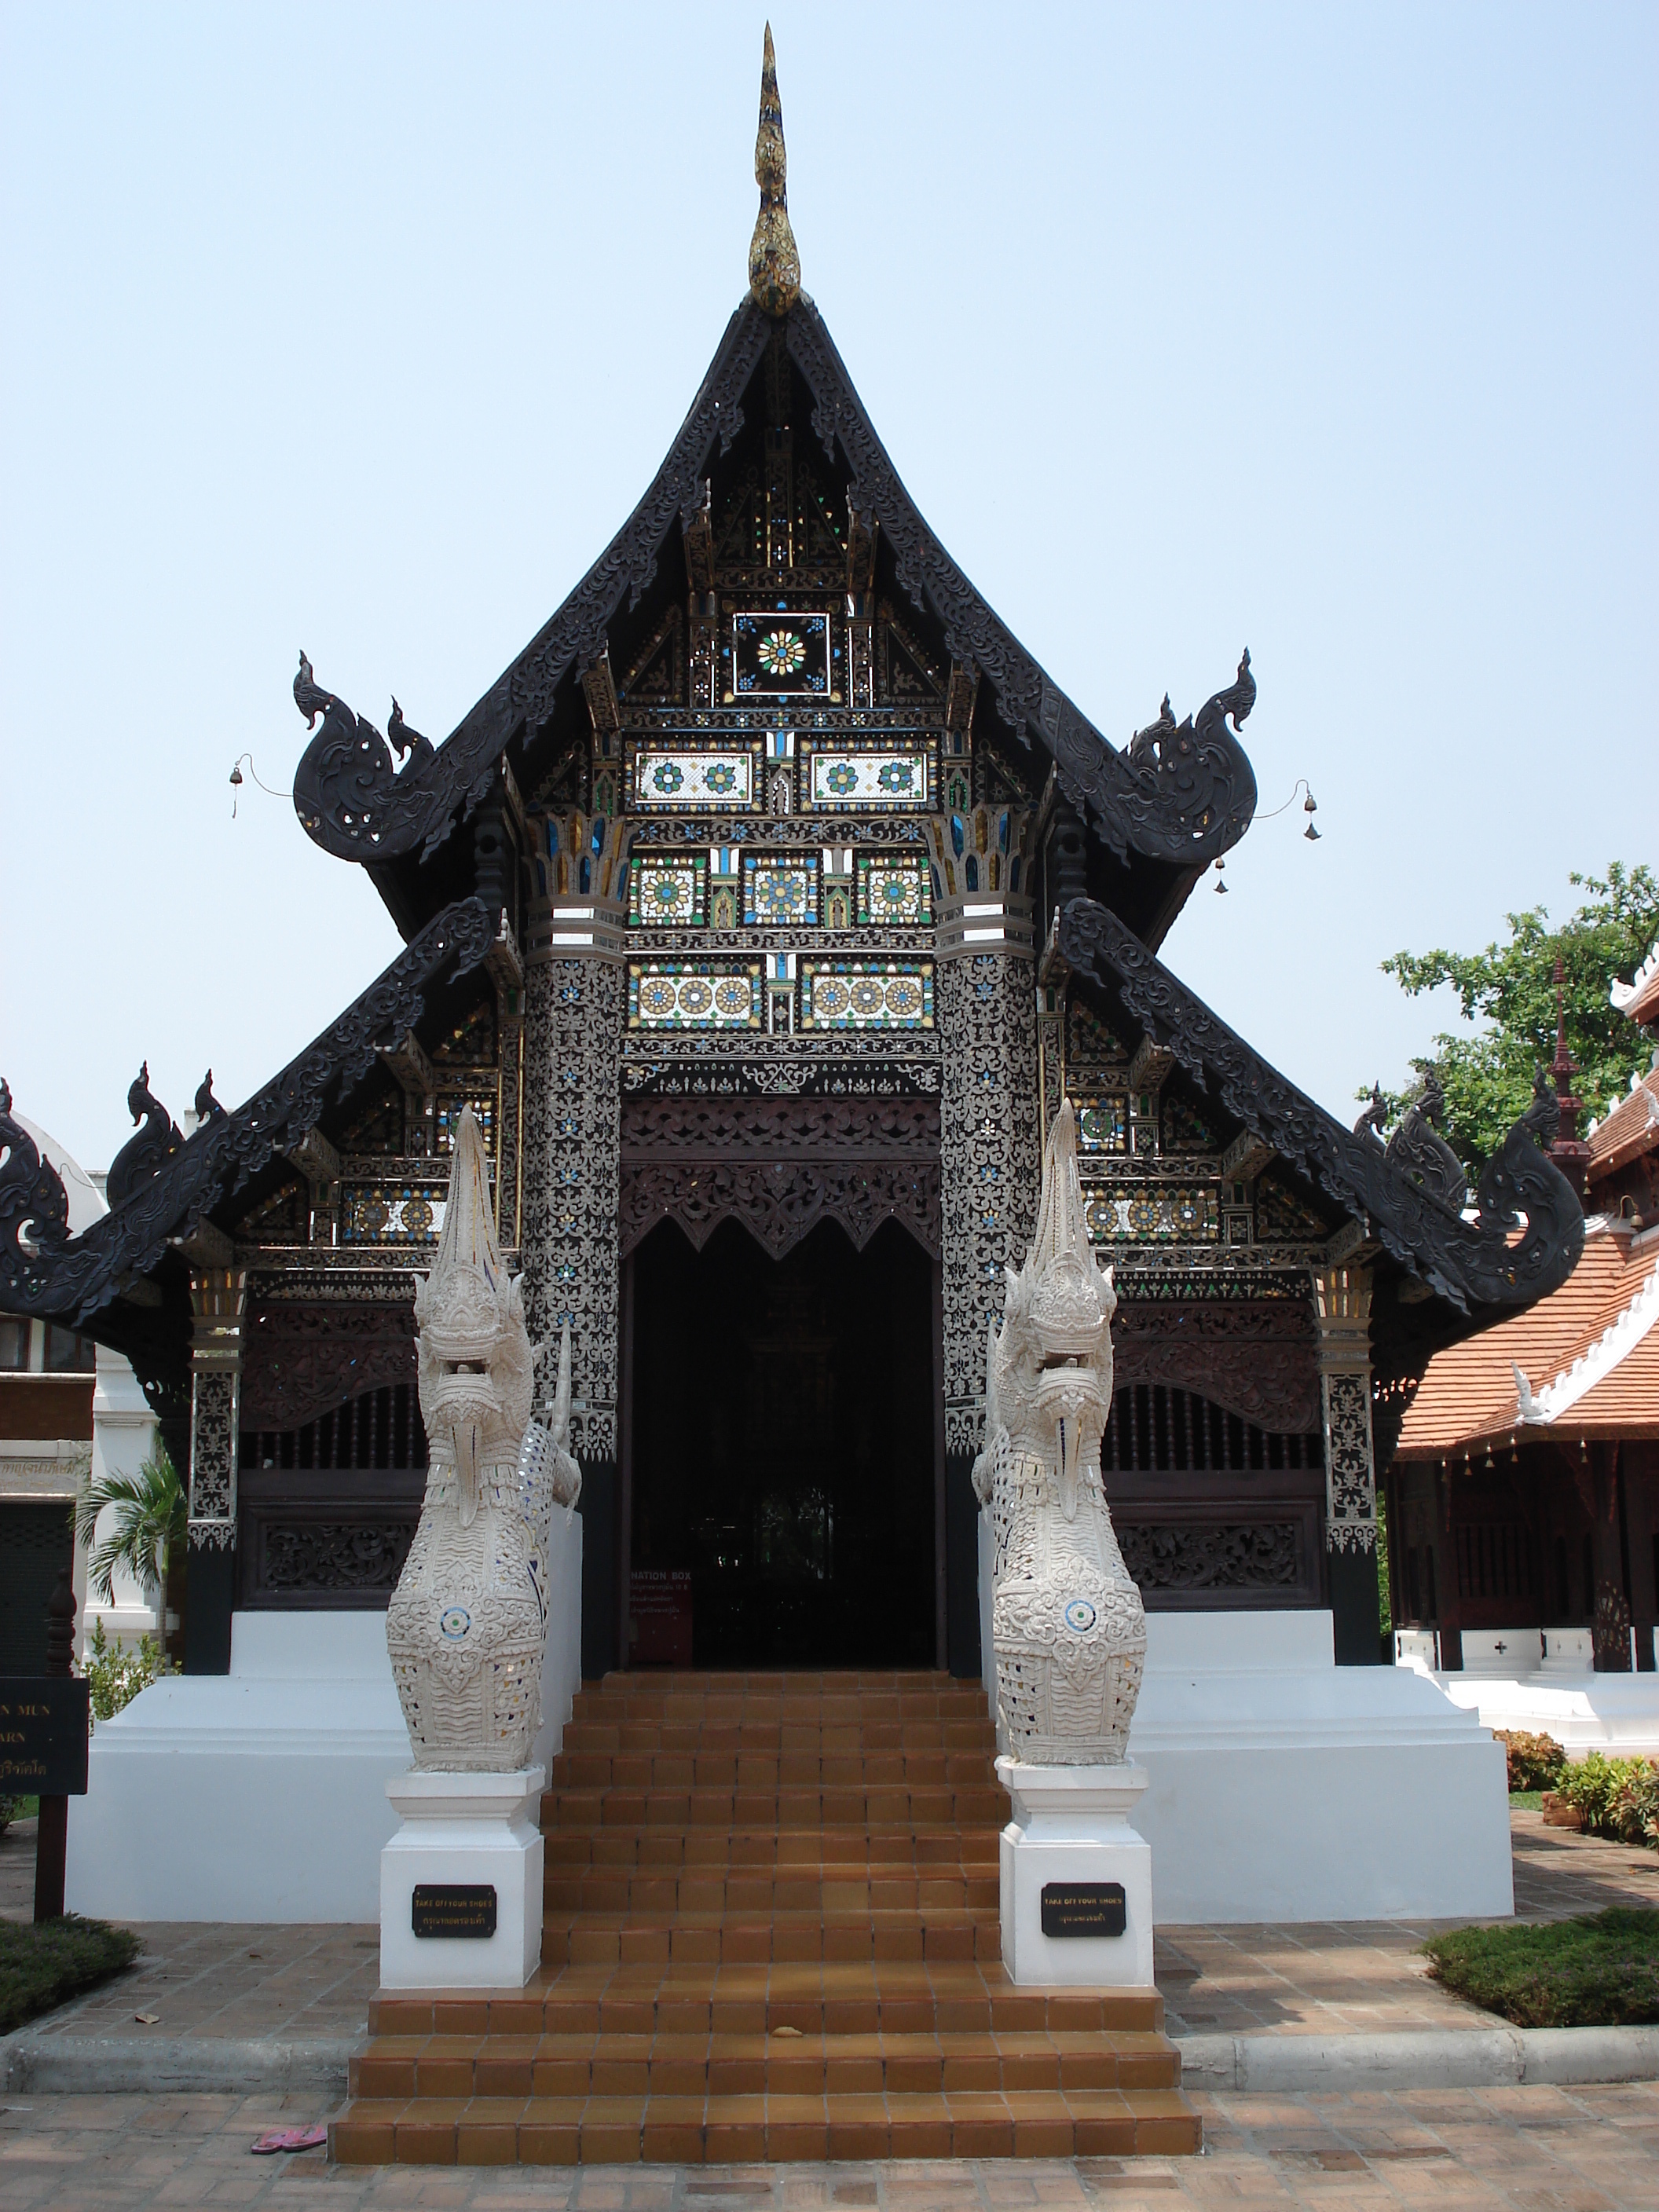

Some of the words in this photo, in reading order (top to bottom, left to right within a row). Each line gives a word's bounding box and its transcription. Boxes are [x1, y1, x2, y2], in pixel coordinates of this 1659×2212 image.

[672, 1572, 691, 1580] BOX
[18, 1704, 50, 1716] MUN
[416, 1899, 433, 1908] TAKE
[449, 1899, 467, 1908] YOUR
[469, 1899, 493, 1908] SHOES
